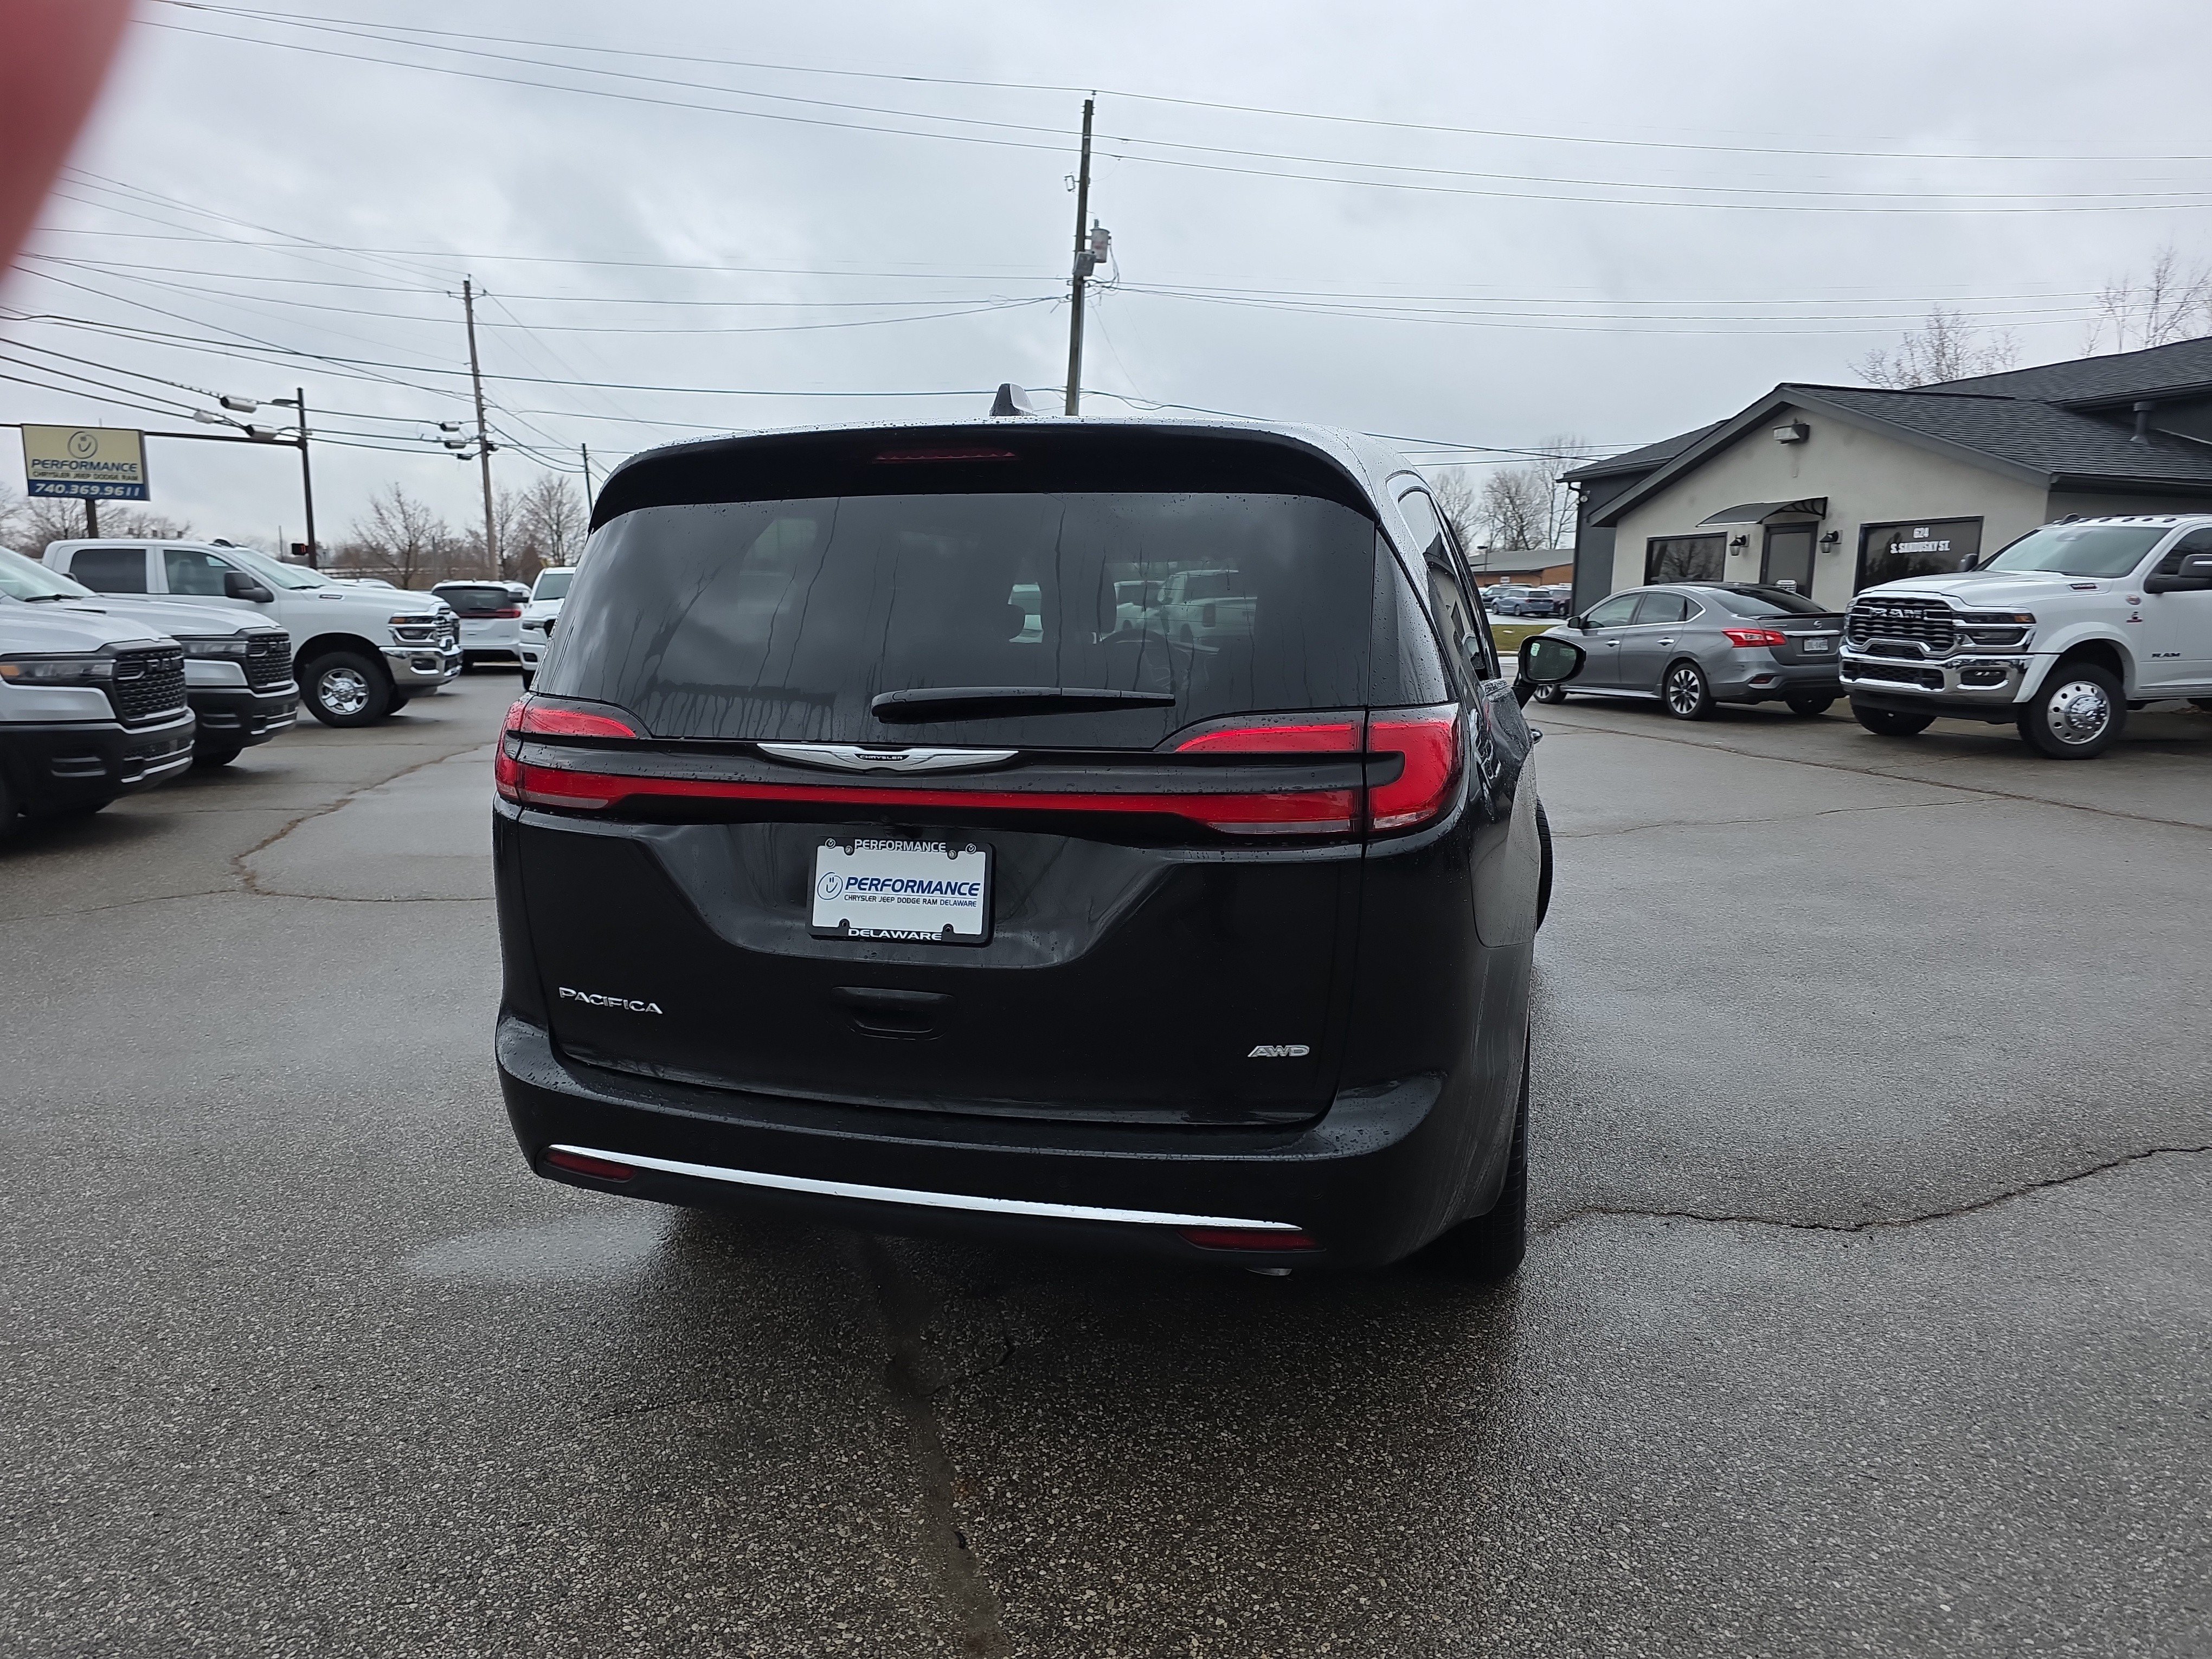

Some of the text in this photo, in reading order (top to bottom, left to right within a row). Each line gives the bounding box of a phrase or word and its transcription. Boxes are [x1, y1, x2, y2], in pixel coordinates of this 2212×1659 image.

[31, 459, 138, 472] PERFORMANCE
[35, 483, 140, 496] 740.369.9611
[1869, 607, 1922, 618] RAM
[854, 839, 946, 852] PERFORMANCE
[845, 877, 981, 896] PERFORMANCE
[940, 899, 977, 907] DELAWARE
[848, 928, 942, 941] DELAWARE
[559, 987, 663, 1014] PACIFICA
[1248, 1045, 1310, 1057] AWD
